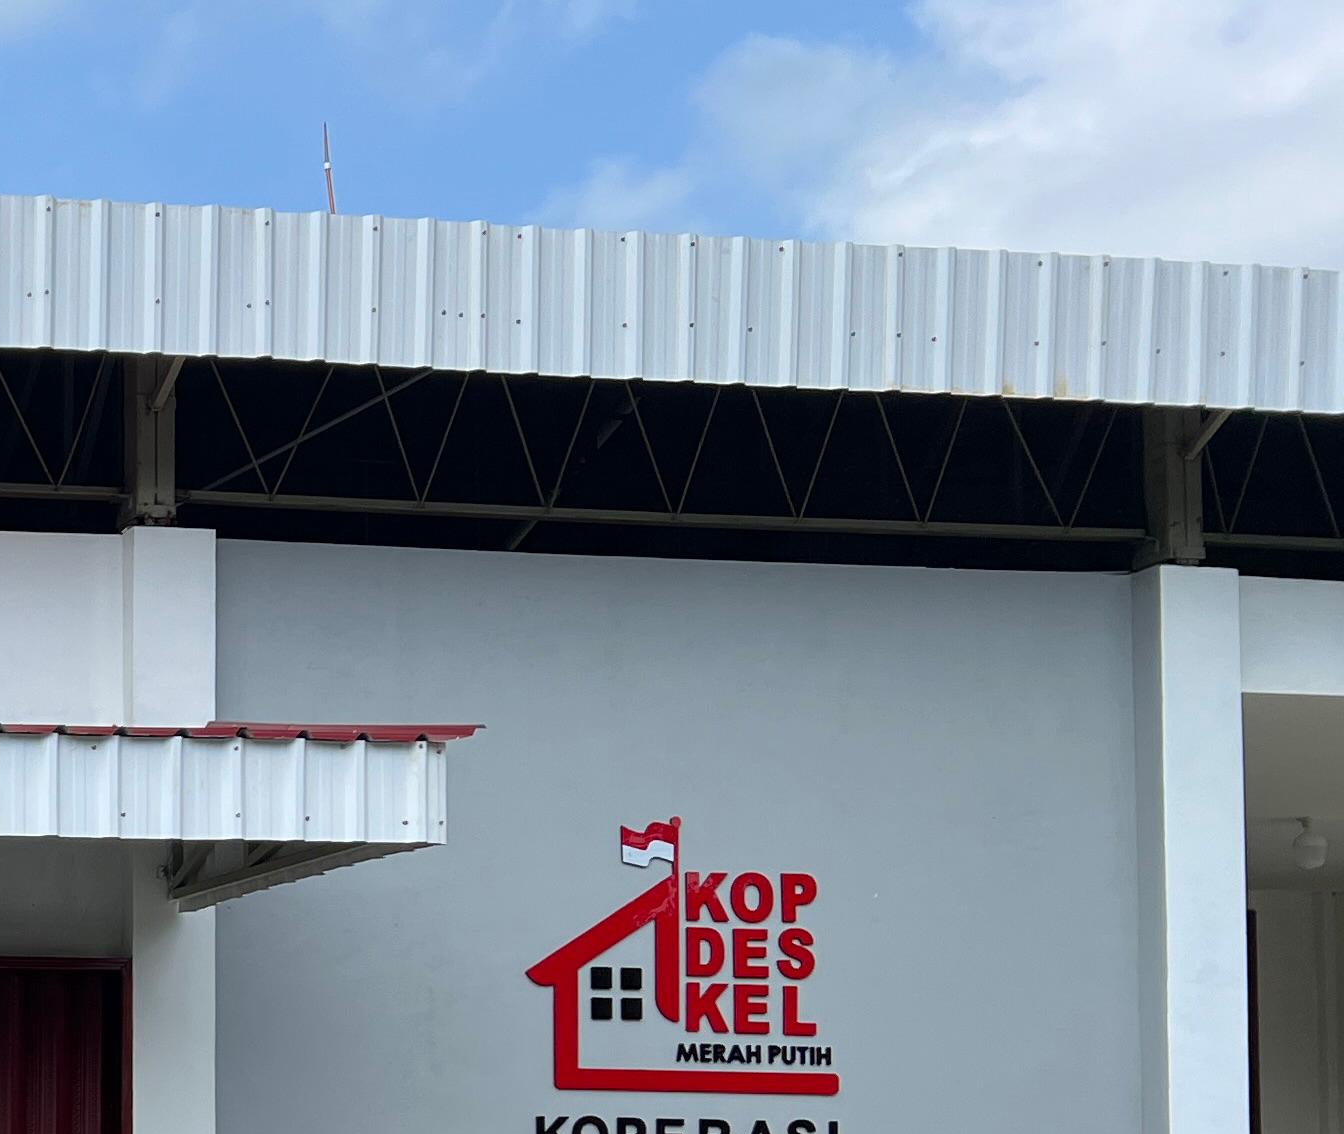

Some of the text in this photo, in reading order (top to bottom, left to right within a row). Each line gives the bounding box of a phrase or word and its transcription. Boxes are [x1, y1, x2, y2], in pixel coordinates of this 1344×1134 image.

[685, 871, 817, 923] KOP
[684, 927, 816, 980] DES
[685, 982, 817, 1036] KEL
[675, 1043, 833, 1067] MERAH PUTIH
